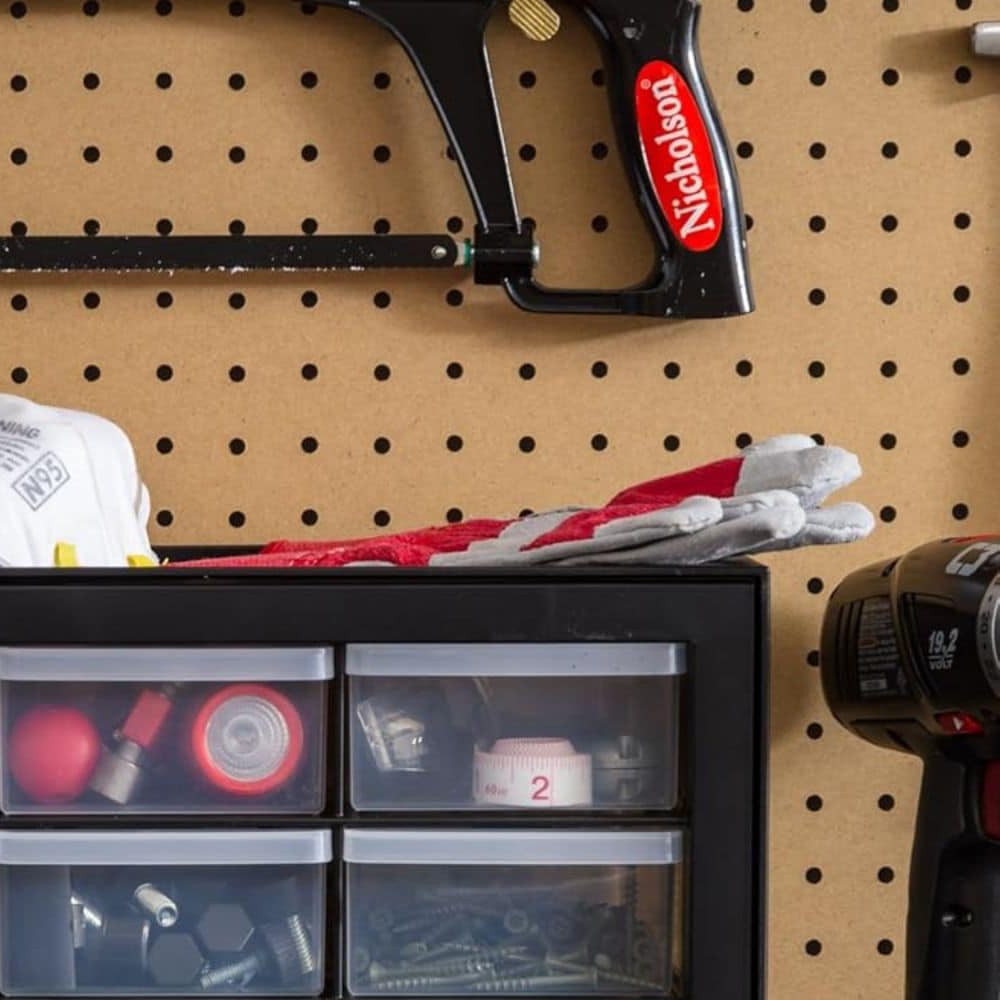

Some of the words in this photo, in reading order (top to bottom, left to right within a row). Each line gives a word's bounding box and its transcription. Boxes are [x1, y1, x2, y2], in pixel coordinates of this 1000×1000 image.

[651, 75, 715, 239] Nicholson
[21, 459, 63, 504] N95
[928, 627, 959, 654] 19.2
[531, 776, 550, 801] 2
